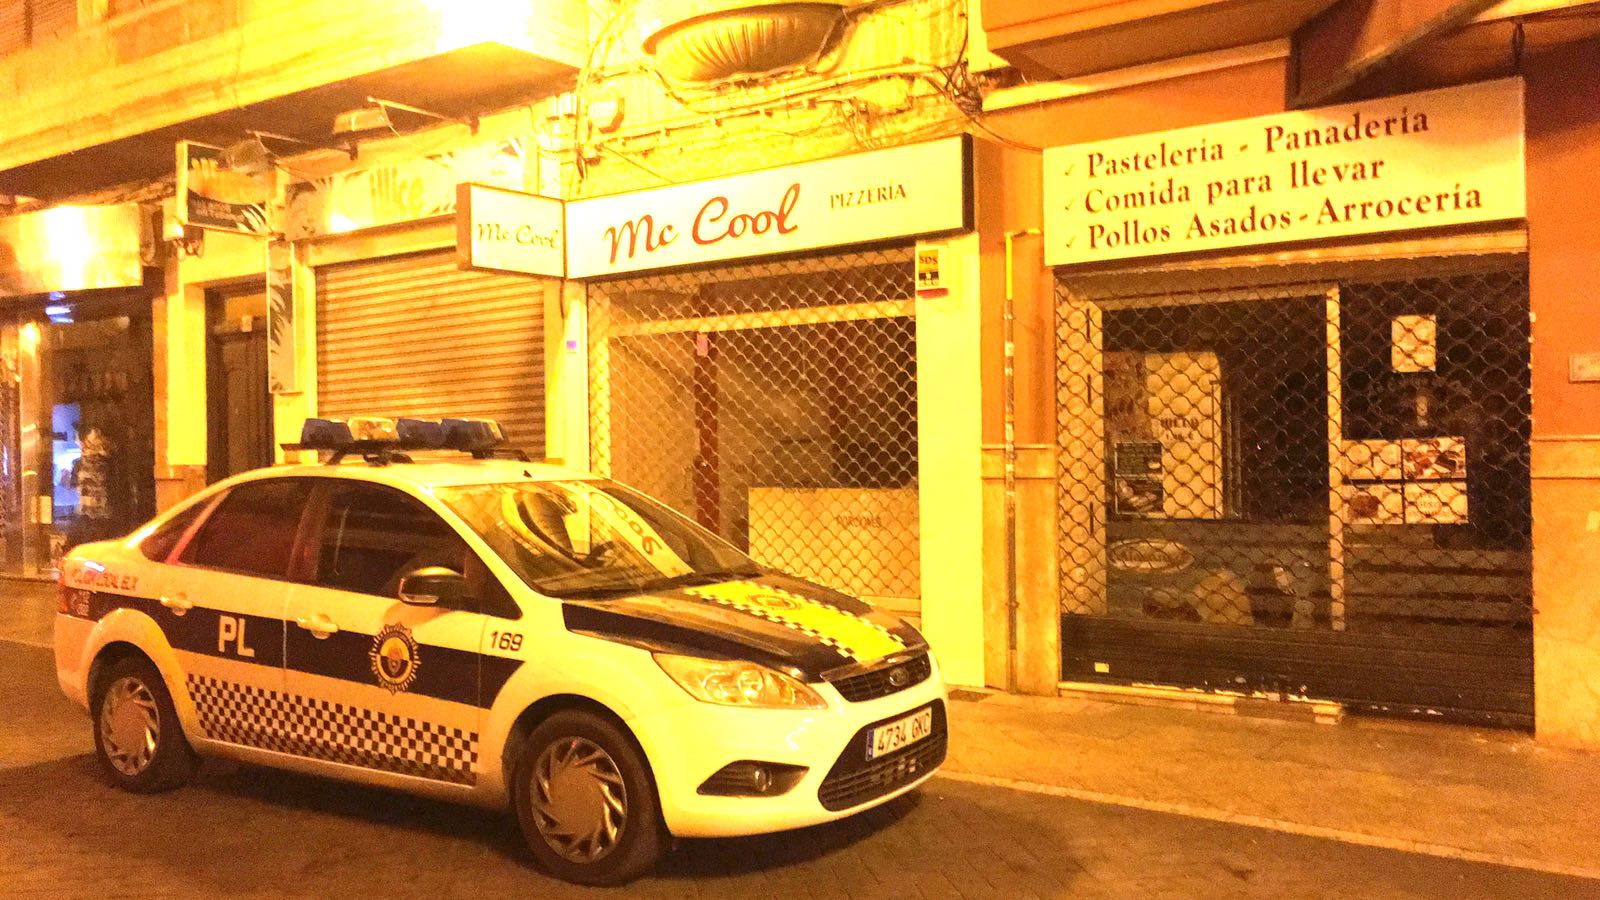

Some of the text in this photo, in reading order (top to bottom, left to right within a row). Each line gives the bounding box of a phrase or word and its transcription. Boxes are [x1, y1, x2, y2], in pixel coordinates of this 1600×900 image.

[1264, 106, 1430, 153] Panadería
[1085, 158, 1385, 214] Comida para llevar
[477, 223, 561, 250] Mc Cool
[602, 183, 906, 265] Mc Cool PIZZERÍA
[1088, 219, 1171, 250] Pollos
[218, 614, 256, 658] PL
[489, 629, 524, 652] 169
[876, 723, 907, 752] 4734
